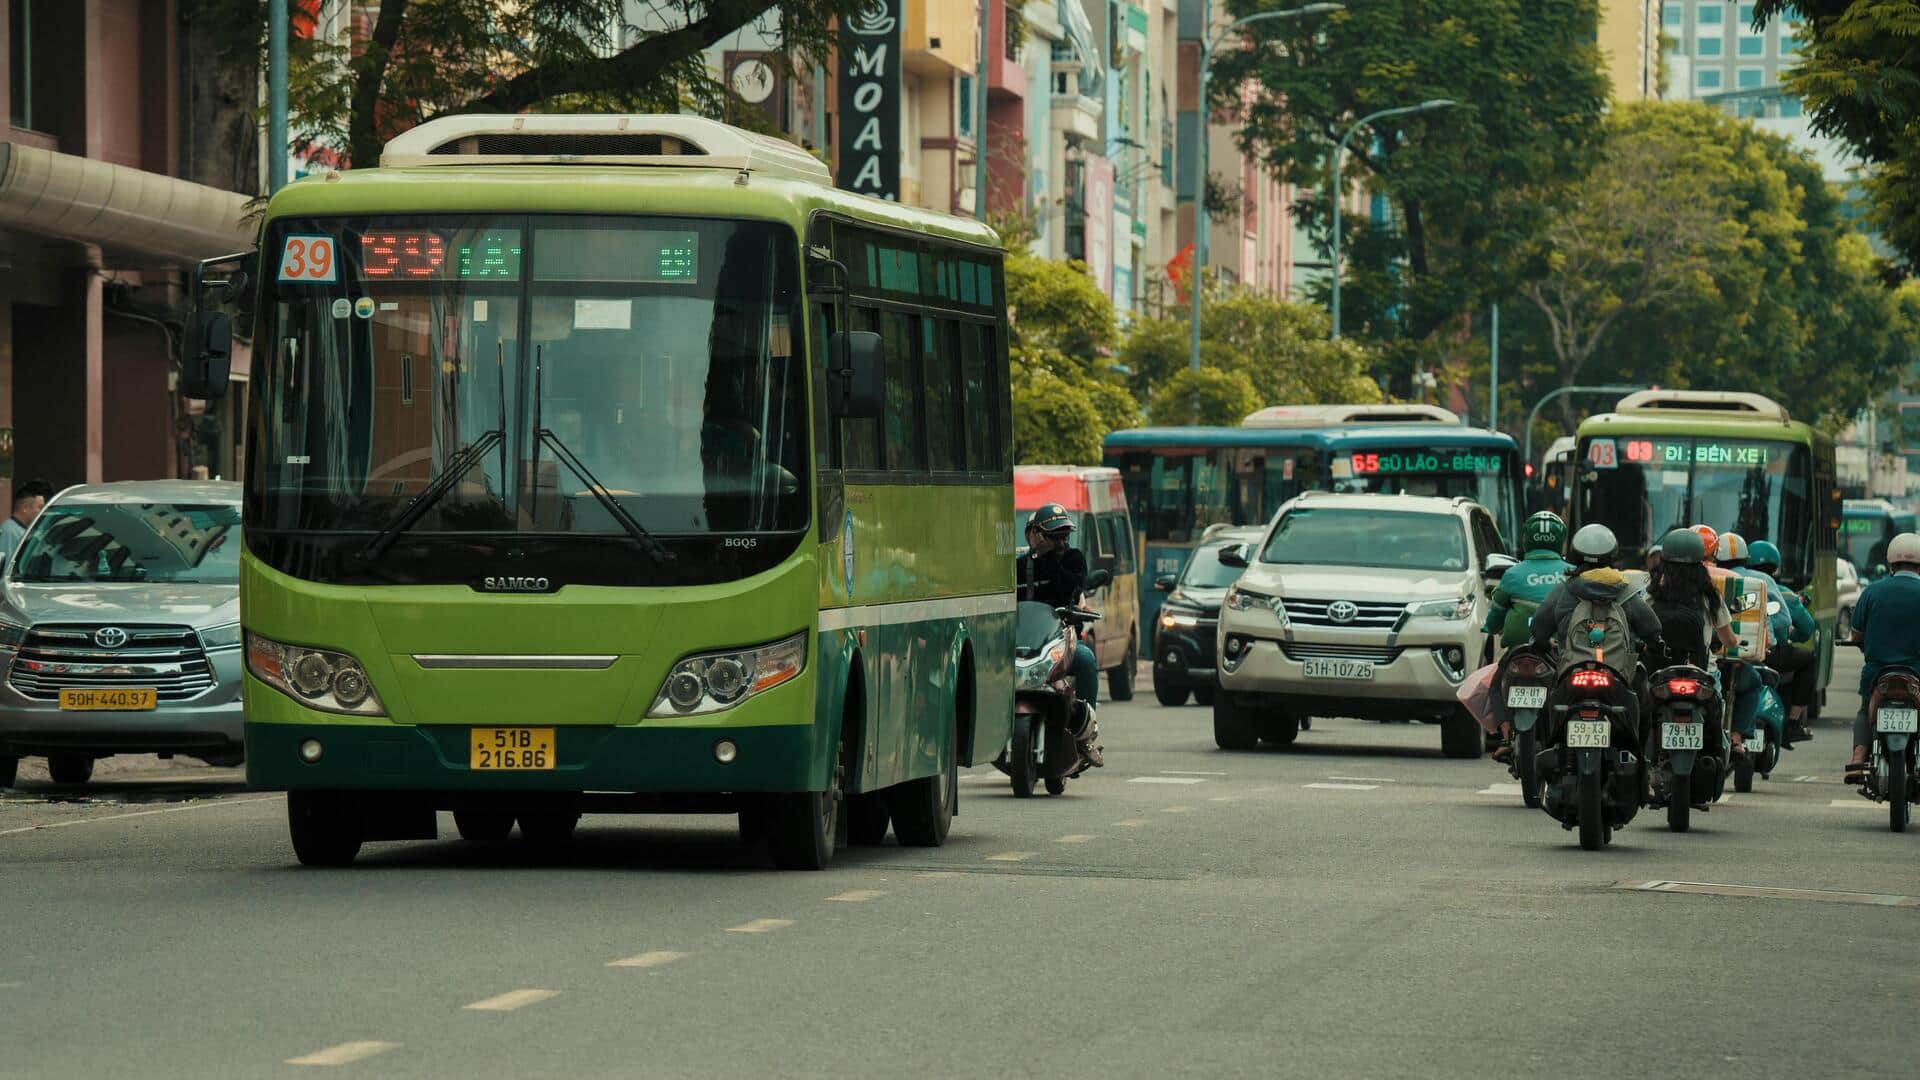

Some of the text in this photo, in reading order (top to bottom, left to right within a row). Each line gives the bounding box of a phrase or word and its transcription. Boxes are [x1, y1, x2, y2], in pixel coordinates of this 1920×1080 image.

[850, 44, 895, 200] MOAA
[284, 239, 332, 278] 39
[1590, 443, 1614, 466] 03
[1736, 448, 1760, 463] XE
[1352, 453, 1378, 473] 65
[1405, 453, 1438, 471] LÃO
[725, 538, 757, 547] BGQ5
[1533, 533, 1556, 542] Grab
[484, 576, 549, 590] SAMCO
[1526, 571, 1566, 586] Grab
[1306, 662, 1371, 677] 51H-107.25
[1574, 722, 1604, 734] 59-X3
[1669, 725, 1696, 736] 79-N3
[495, 730, 531, 748] 51B
